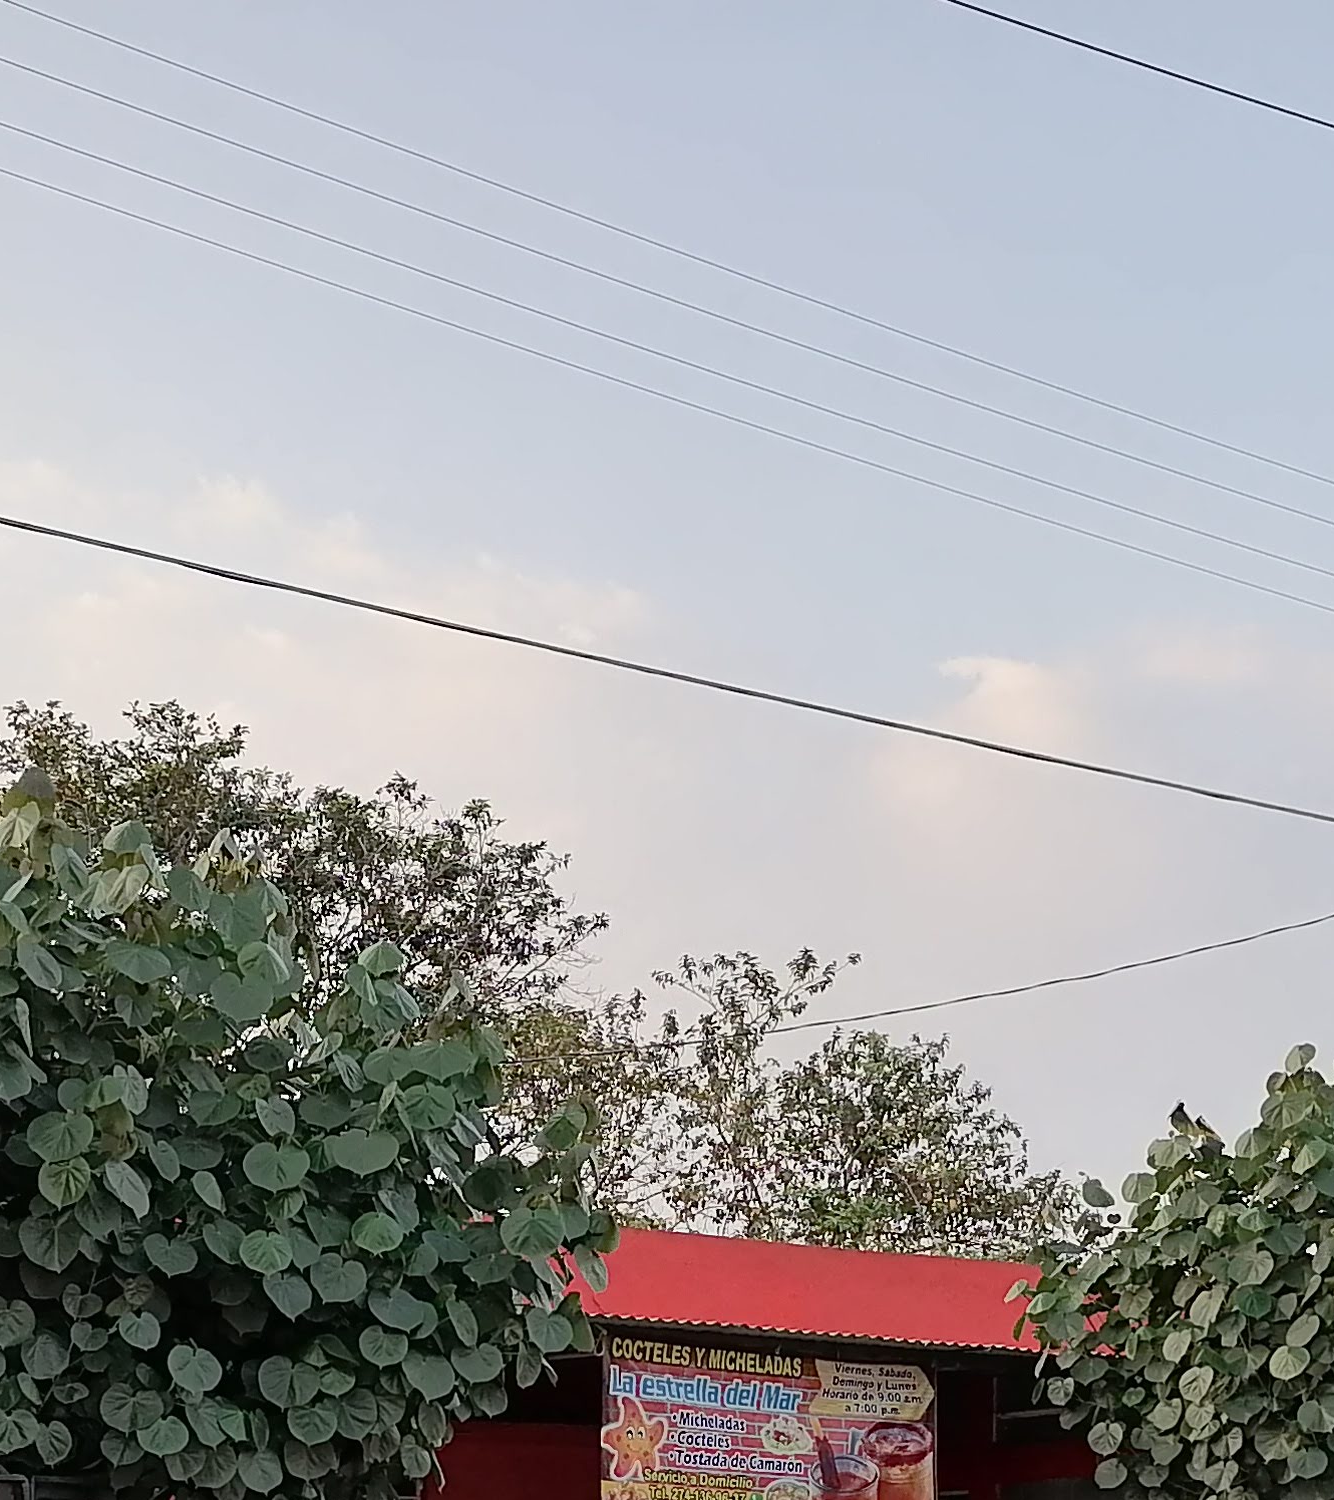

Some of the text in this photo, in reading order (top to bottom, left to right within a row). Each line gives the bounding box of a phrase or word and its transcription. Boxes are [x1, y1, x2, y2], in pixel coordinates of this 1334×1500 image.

[612, 1337, 802, 1377] COCTELES Y MICHELADAS
[835, 1363, 874, 1377] Viernes,
[611, 1367, 802, 1411] La estrella del Mar
[832, 1376, 874, 1390] Domingo
[877, 1381, 883, 1391] y
[822, 1388, 859, 1400] Horario
[854, 1404, 877, 1413] 7:00
[679, 1412, 745, 1431] Micheladas
[678, 1431, 730, 1448] Cocteles
[675, 1450, 802, 1473] Tostada de Camarón
[644, 1469, 753, 1488] Servicio a Domicilio
